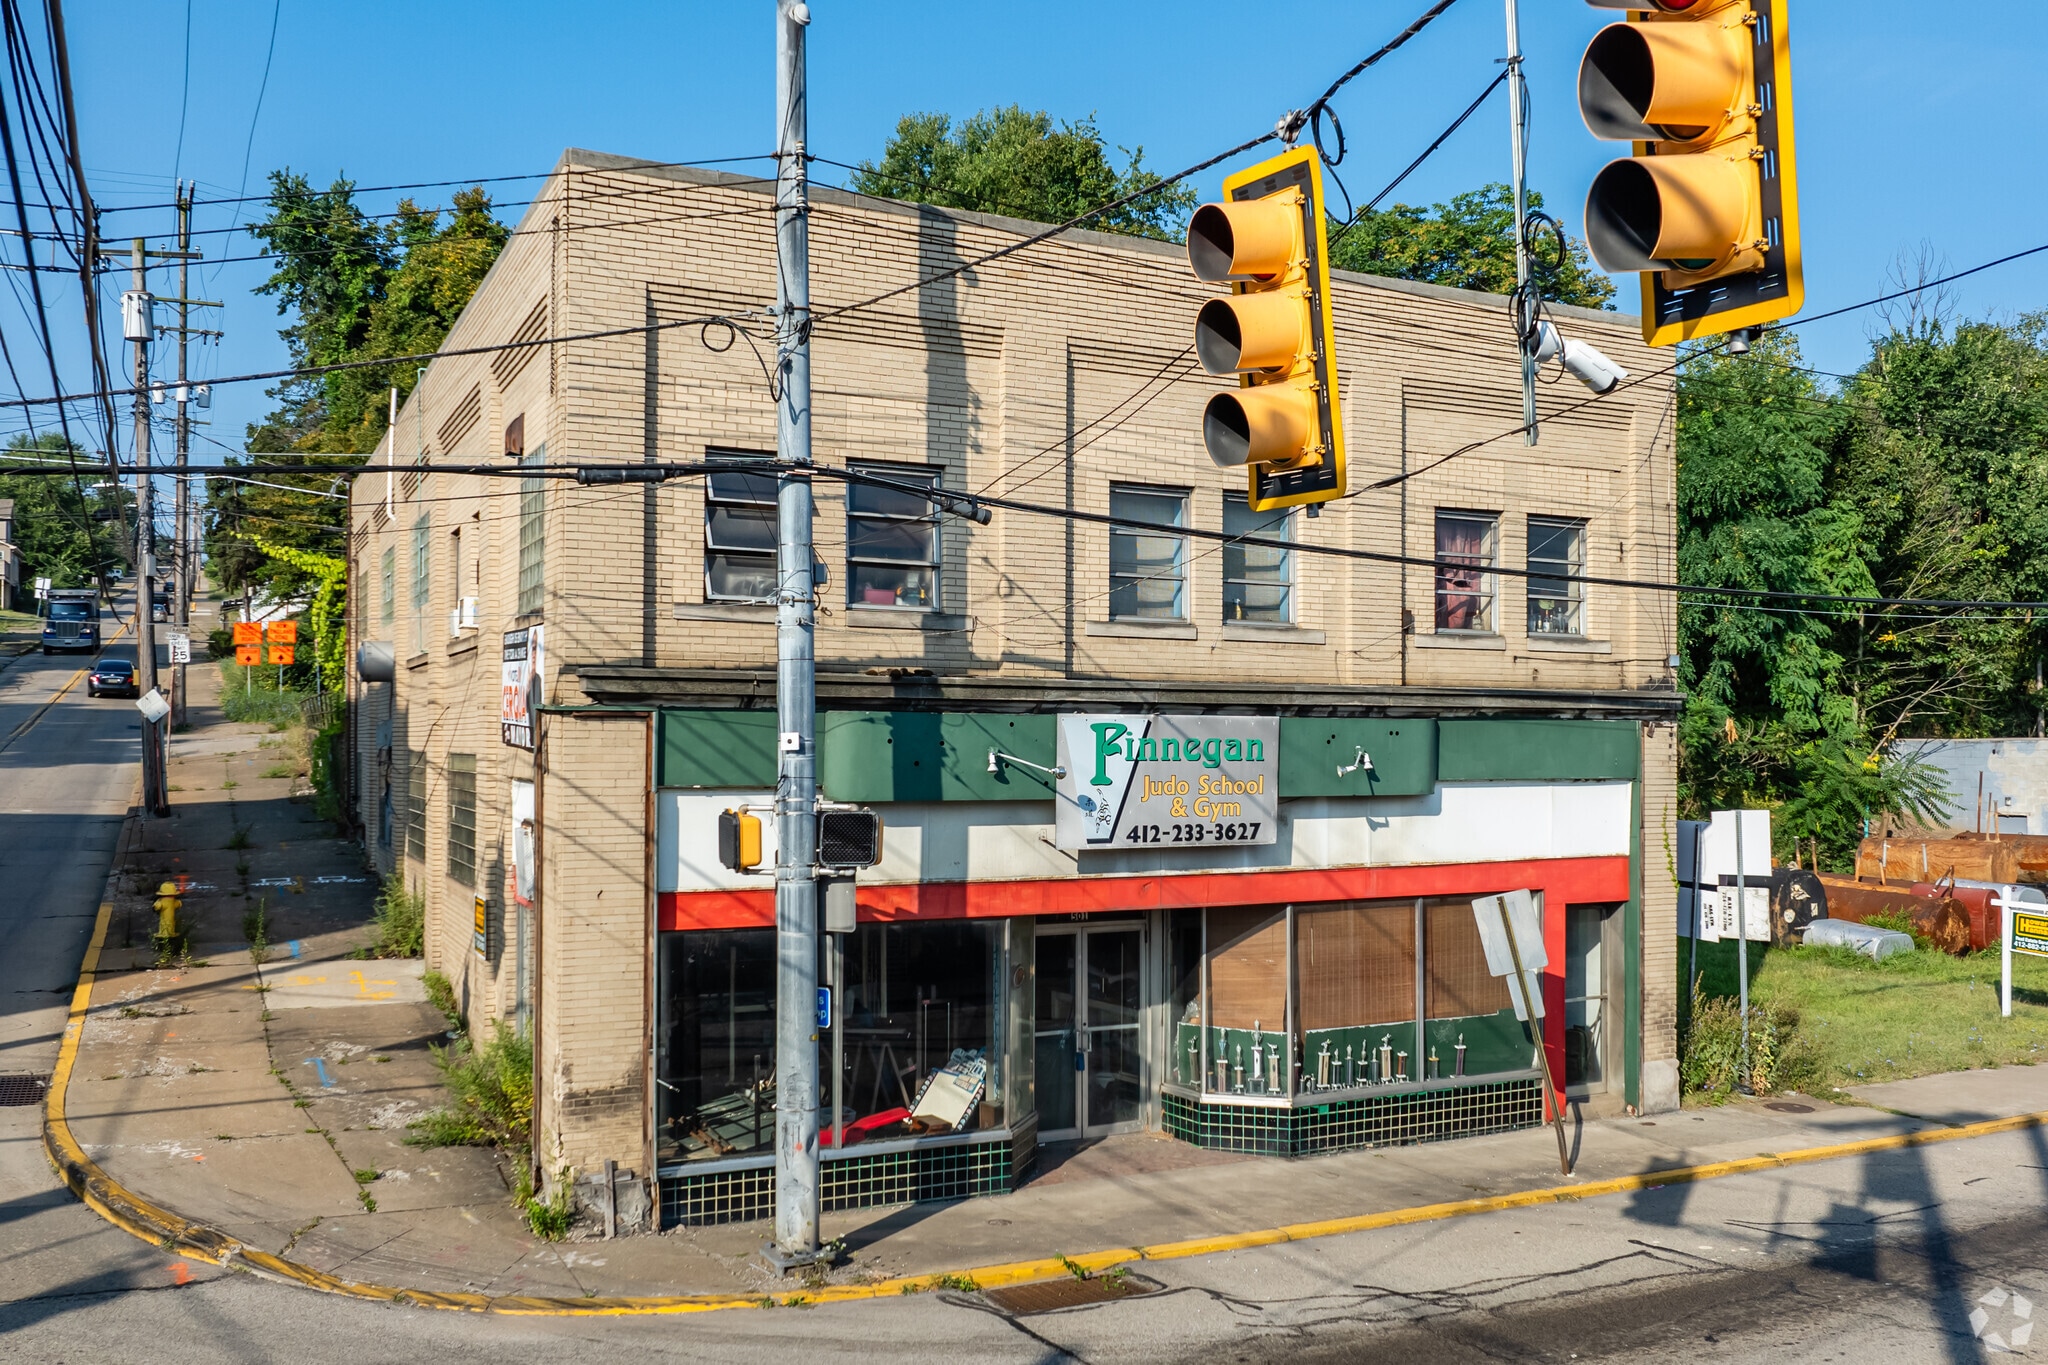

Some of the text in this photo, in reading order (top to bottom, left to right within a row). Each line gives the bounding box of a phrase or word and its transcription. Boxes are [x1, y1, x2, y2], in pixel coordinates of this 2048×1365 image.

[173, 651, 188, 660] 25
[1090, 722, 1265, 787] Finnegan
[1141, 774, 1265, 803] Judo School
[1170, 796, 1242, 823] & Gym
[1126, 822, 1262, 843] 412-233-3627
[1072, 912, 1087, 921] 501
